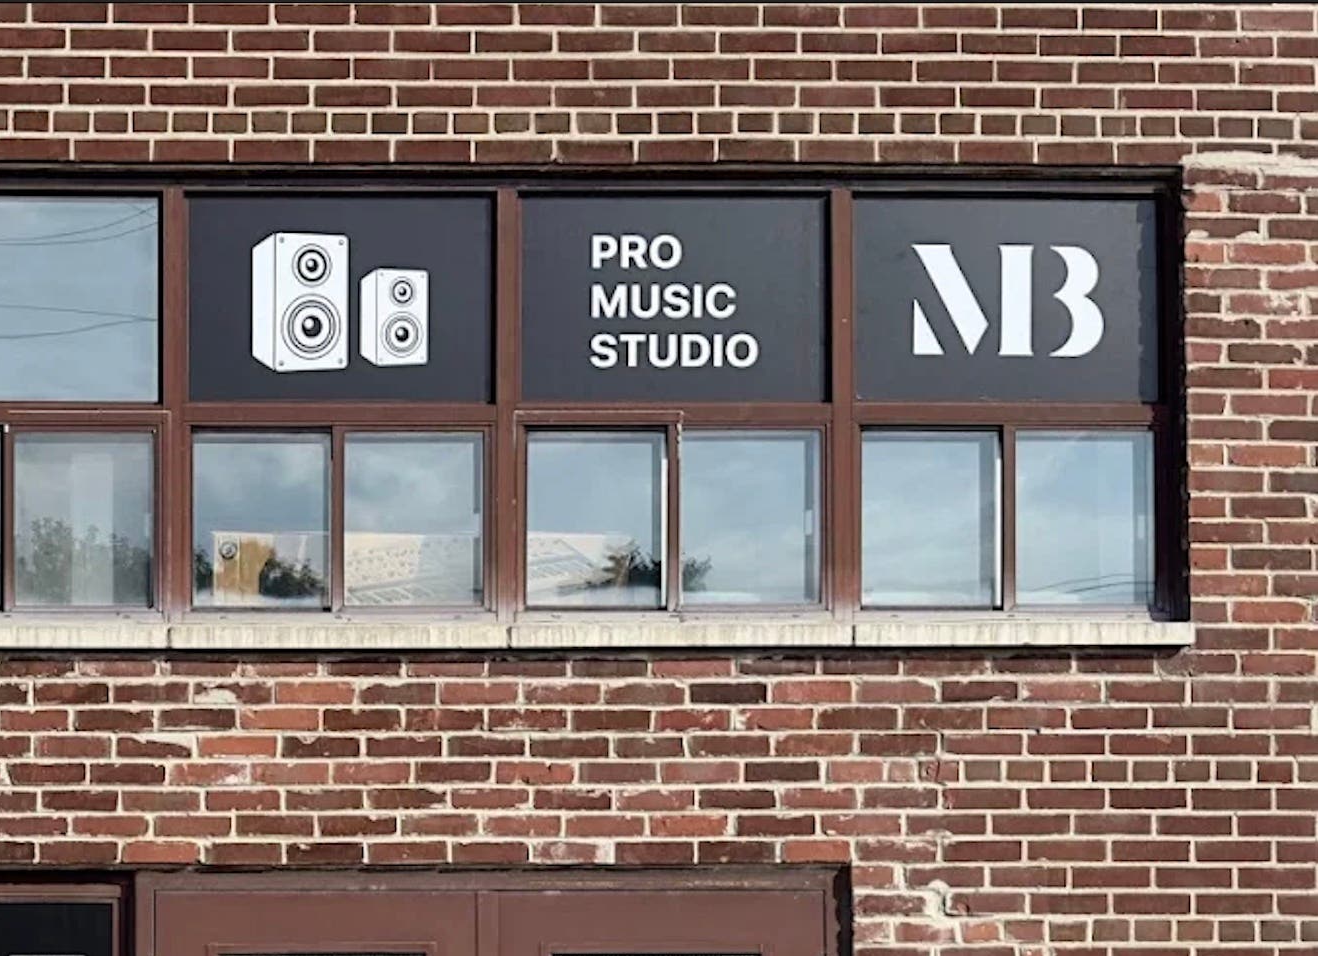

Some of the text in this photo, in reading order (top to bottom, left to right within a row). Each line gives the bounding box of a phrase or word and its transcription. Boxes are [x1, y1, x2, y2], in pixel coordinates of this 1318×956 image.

[593, 235, 681, 269] PRO
[592, 284, 736, 318] MUSIC
[912, 245, 1103, 356] MB
[591, 334, 758, 367] STUDIO
